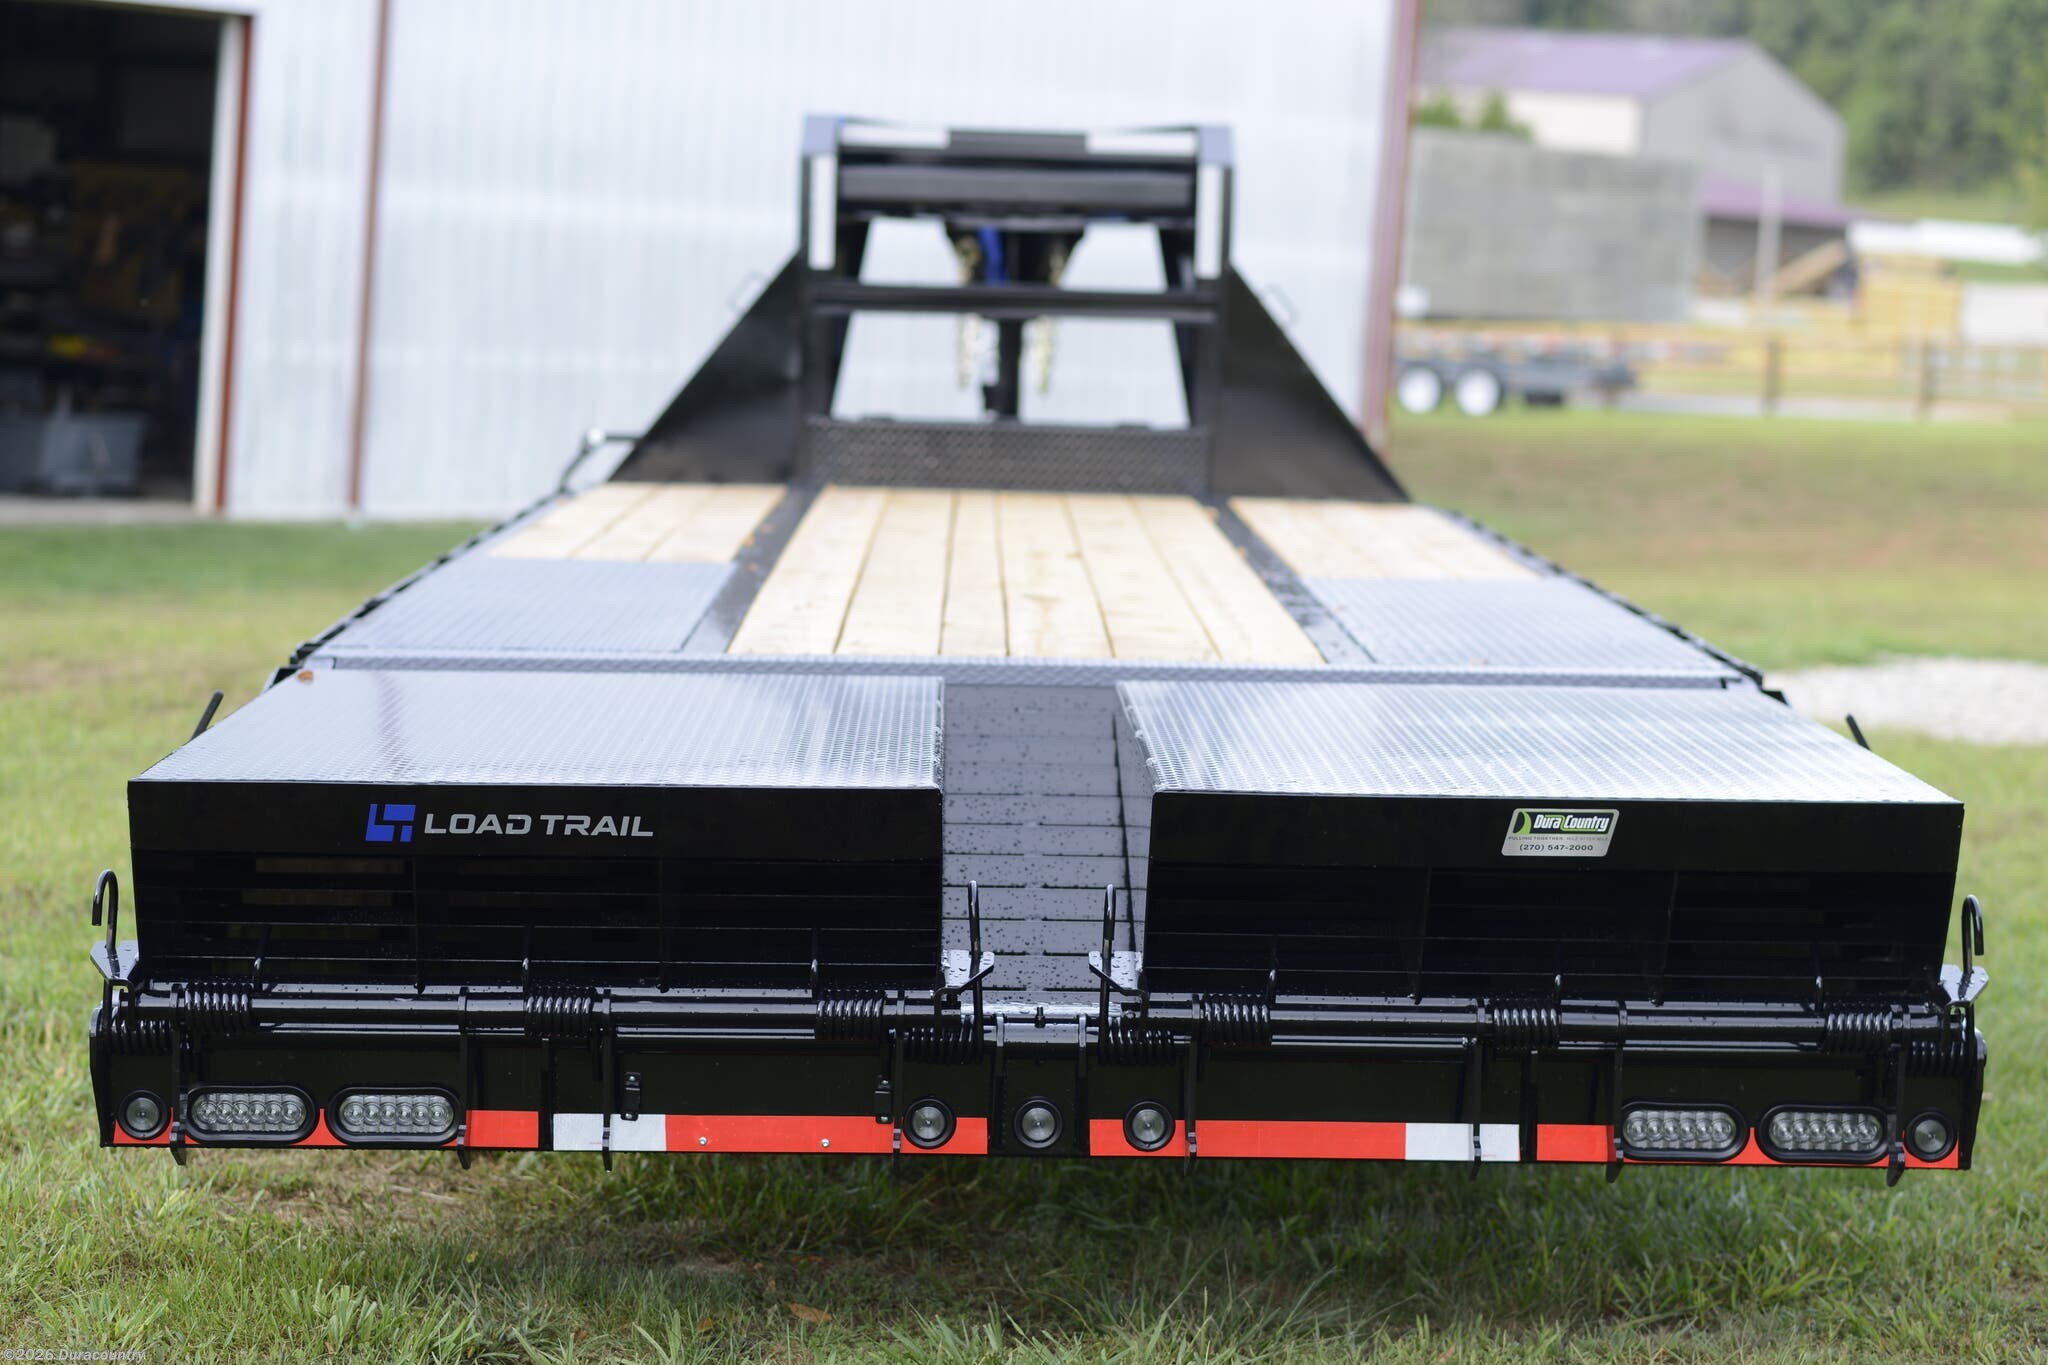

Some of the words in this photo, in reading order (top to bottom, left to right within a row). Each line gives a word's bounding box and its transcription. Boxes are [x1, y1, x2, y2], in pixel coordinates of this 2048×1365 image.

[424, 813, 532, 835] LOAD
[540, 815, 654, 837] TRAIL
[1533, 814, 1561, 829] Dura
[1563, 815, 1609, 832] Country
